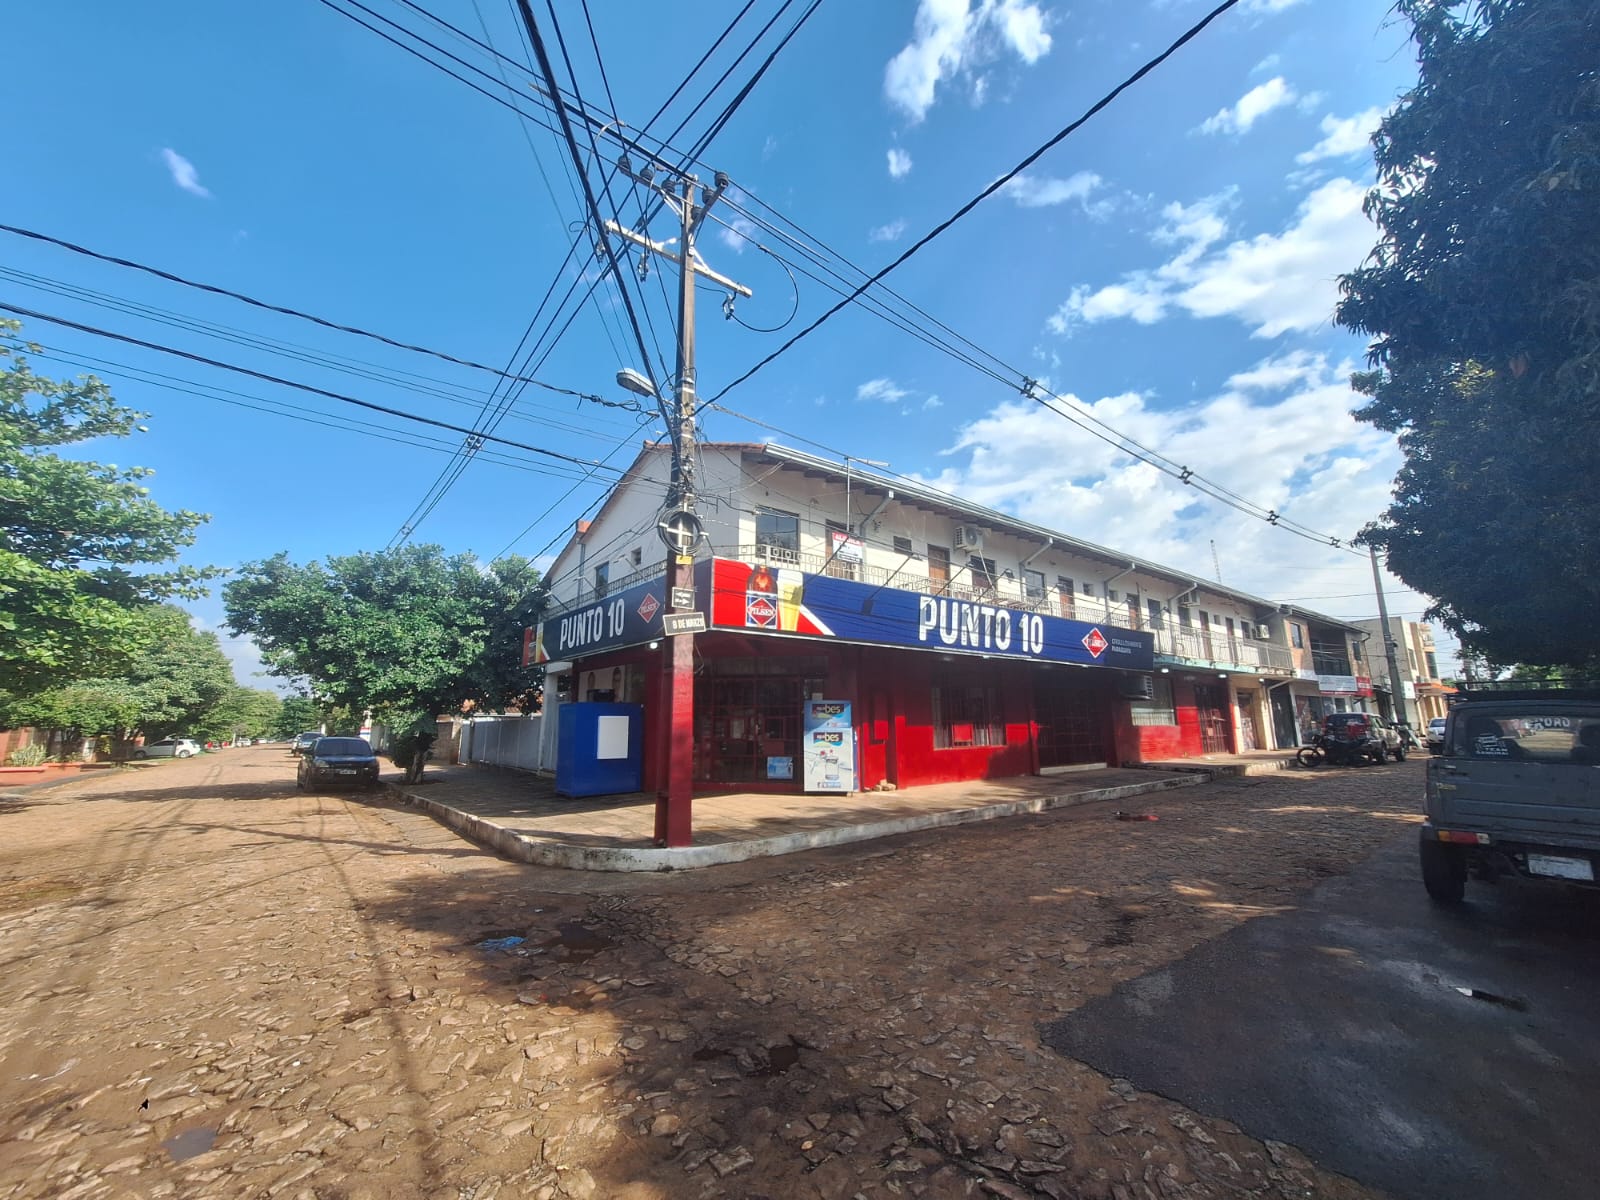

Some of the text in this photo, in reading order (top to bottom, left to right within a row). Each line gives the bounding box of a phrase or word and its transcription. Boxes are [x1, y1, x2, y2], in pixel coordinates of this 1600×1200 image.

[560, 598, 625, 650] PUNTO 10
[919, 596, 1043, 654] PUNTO 10
[825, 731, 840, 742] bes
